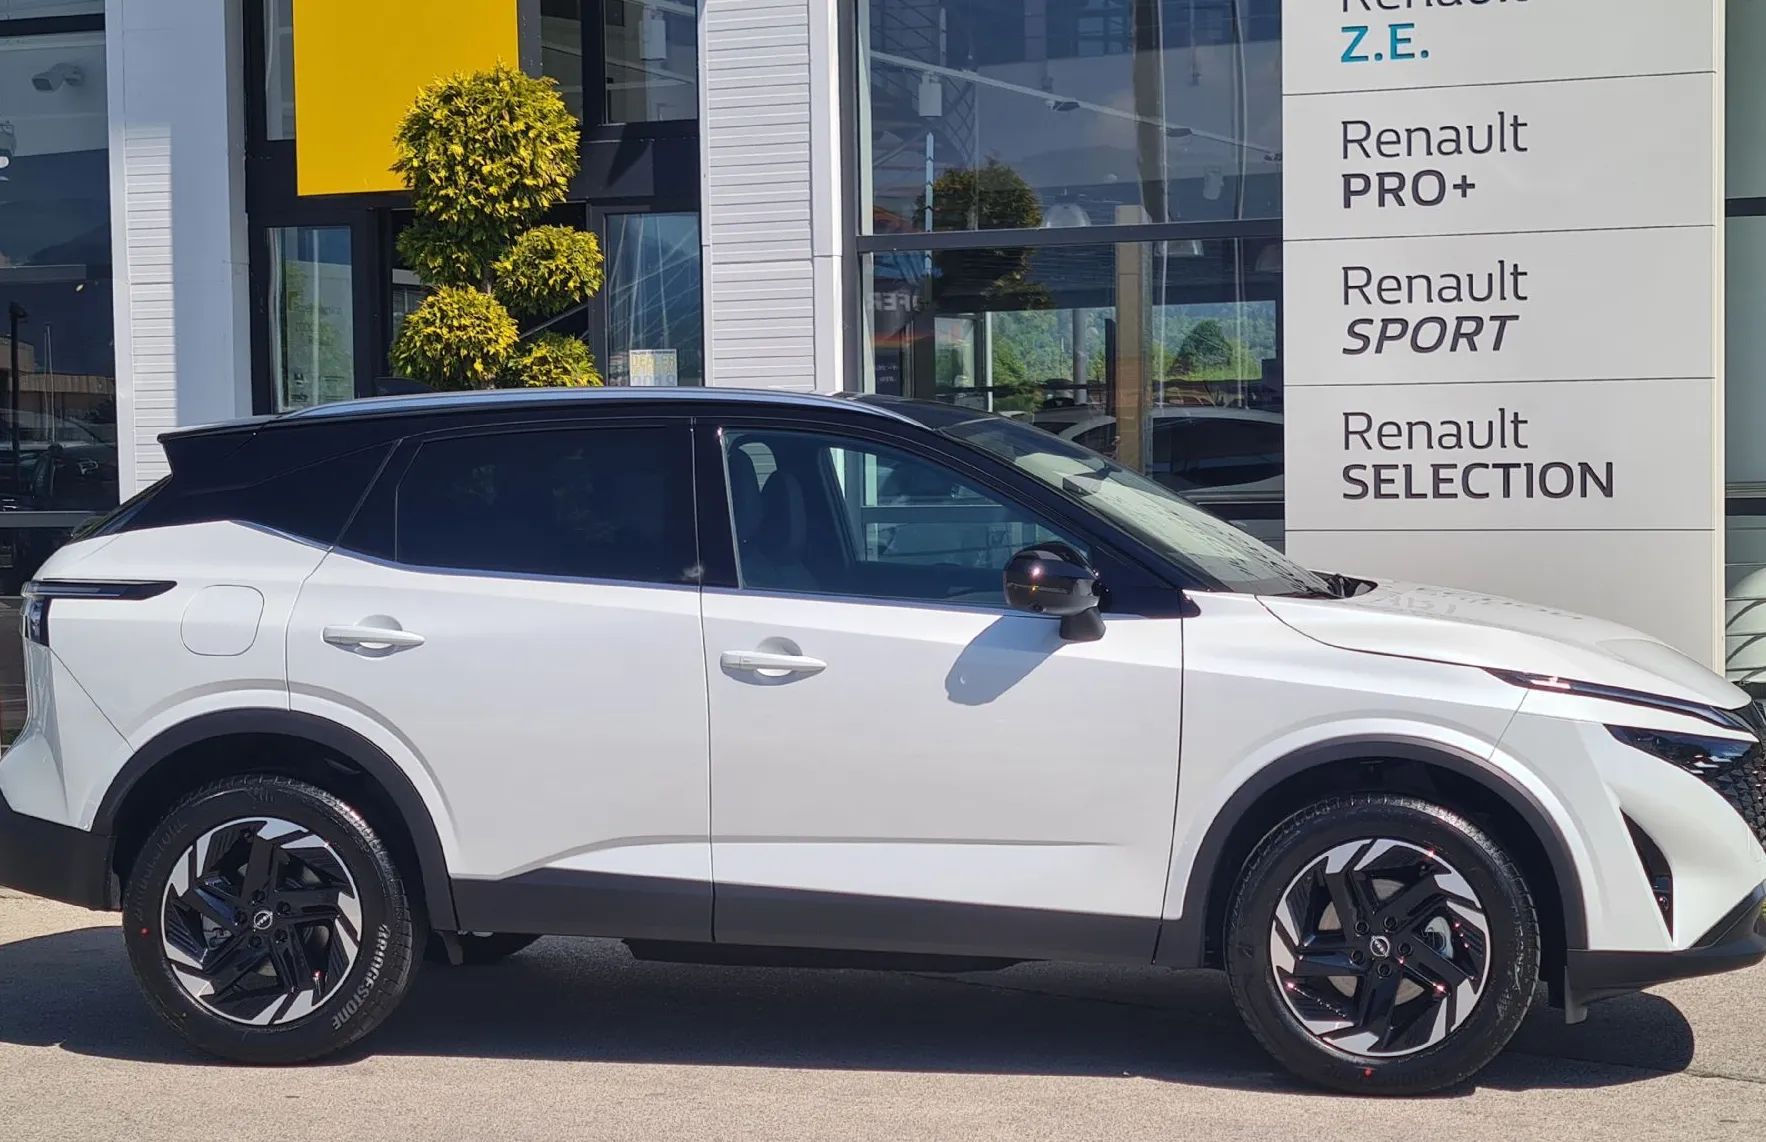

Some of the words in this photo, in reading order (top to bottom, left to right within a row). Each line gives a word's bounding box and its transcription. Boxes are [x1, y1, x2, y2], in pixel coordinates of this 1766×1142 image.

[1340, 22, 1430, 64] Z.E.
[1340, 110, 1529, 160] Renault
[1340, 169, 1476, 210] PRO+
[1341, 259, 1529, 306] Renault
[1341, 314, 1521, 356] SPORT
[1342, 407, 1529, 451] Renault
[1342, 461, 1614, 501] SELECTION
